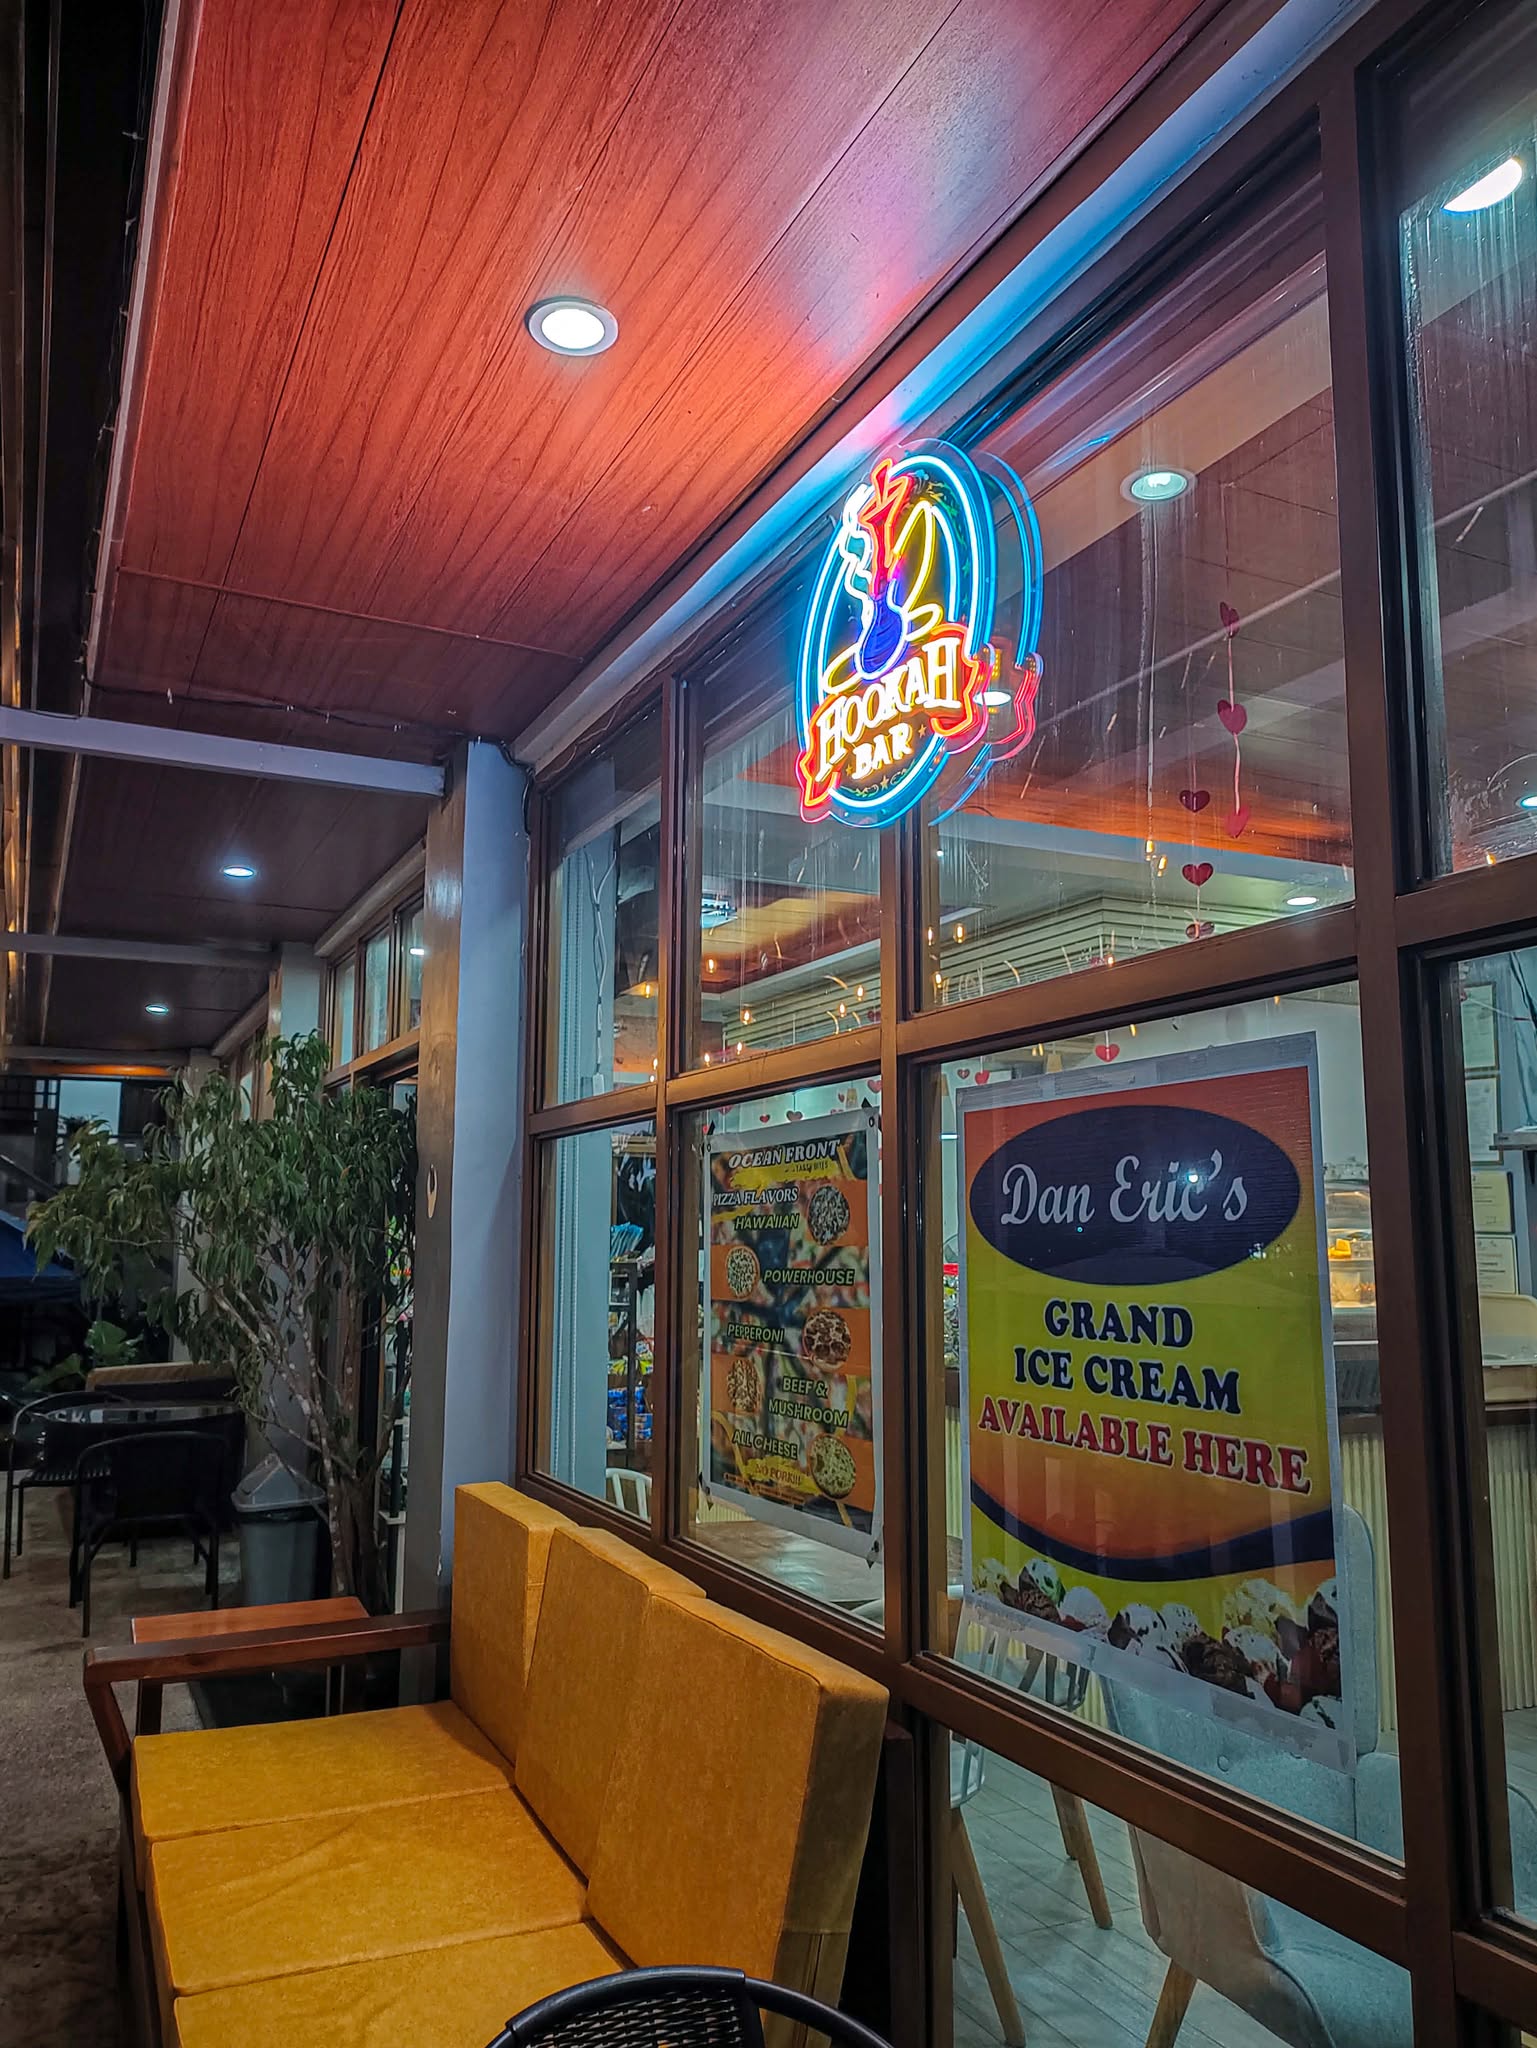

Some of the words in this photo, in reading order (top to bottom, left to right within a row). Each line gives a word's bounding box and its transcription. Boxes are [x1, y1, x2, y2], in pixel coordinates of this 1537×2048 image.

[814, 636, 961, 783] HOOKAH
[851, 721, 913, 782] BAR
[728, 1147, 782, 1169] OCEAN
[785, 1139, 841, 1163] FRONT
[713, 1190, 743, 1207] PIZZA
[743, 1186, 799, 1206] FLAVORS
[1000, 1163, 1096, 1226] Dan
[1109, 1150, 1247, 1223] Eric's
[735, 1213, 800, 1231] HAWAIIAN
[763, 1268, 855, 1286] POWERHOUSE
[727, 1323, 785, 1343] PEPPERONI
[1044, 1298, 1194, 1349] GRAND
[783, 1377, 813, 1396] BEEF
[814, 1382, 829, 1399] &
[1013, 1346, 1074, 1391] ICE
[1083, 1355, 1241, 1415] CREAM
[768, 1399, 849, 1428] MUSHROOM
[732, 1429, 753, 1449] ALL
[753, 1433, 798, 1460] CHEESE
[979, 1396, 1173, 1467] AVAILABLE
[1182, 1428, 1313, 1497] HERE
[755, 1463, 768, 1476] NO
